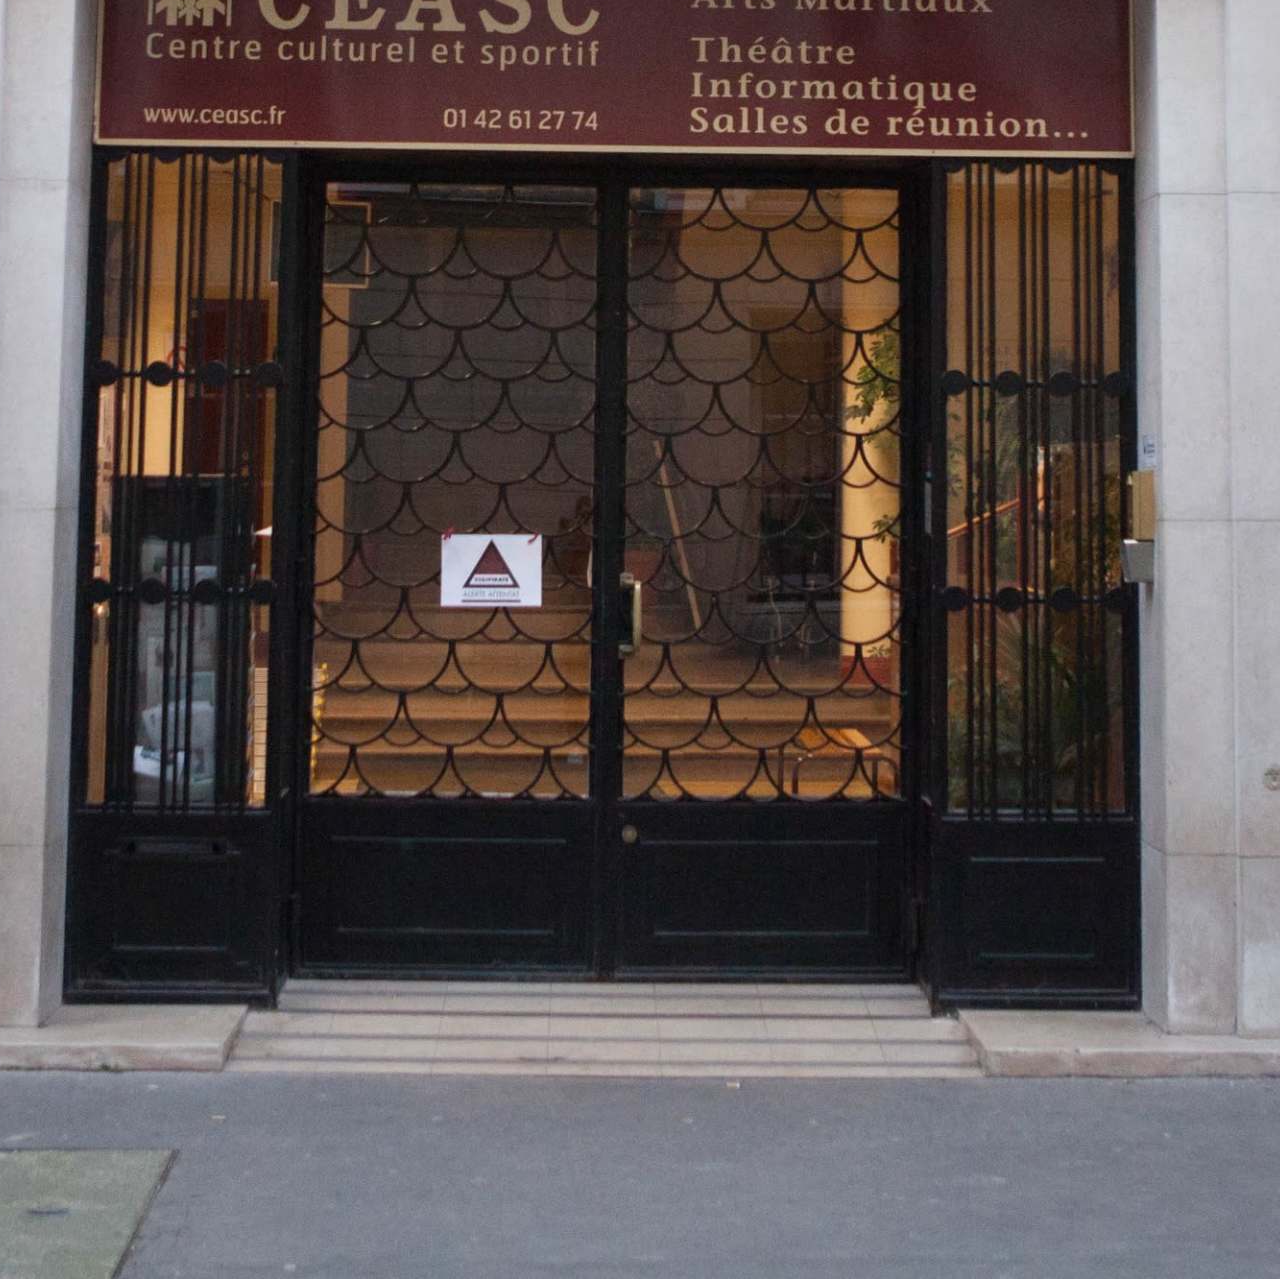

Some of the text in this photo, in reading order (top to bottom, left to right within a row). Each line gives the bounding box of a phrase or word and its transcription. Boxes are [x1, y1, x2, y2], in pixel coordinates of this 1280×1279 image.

[145, 32, 601, 71] Centre culturel et sportif
[690, 36, 857, 65] Théâtre
[690, 72, 978, 109] Informatique
[143, 106, 287, 126] www.ceasc.fr
[443, 108, 599, 131] 01 42 61 27 74
[690, 107, 1090, 138] Salles de réunion...
